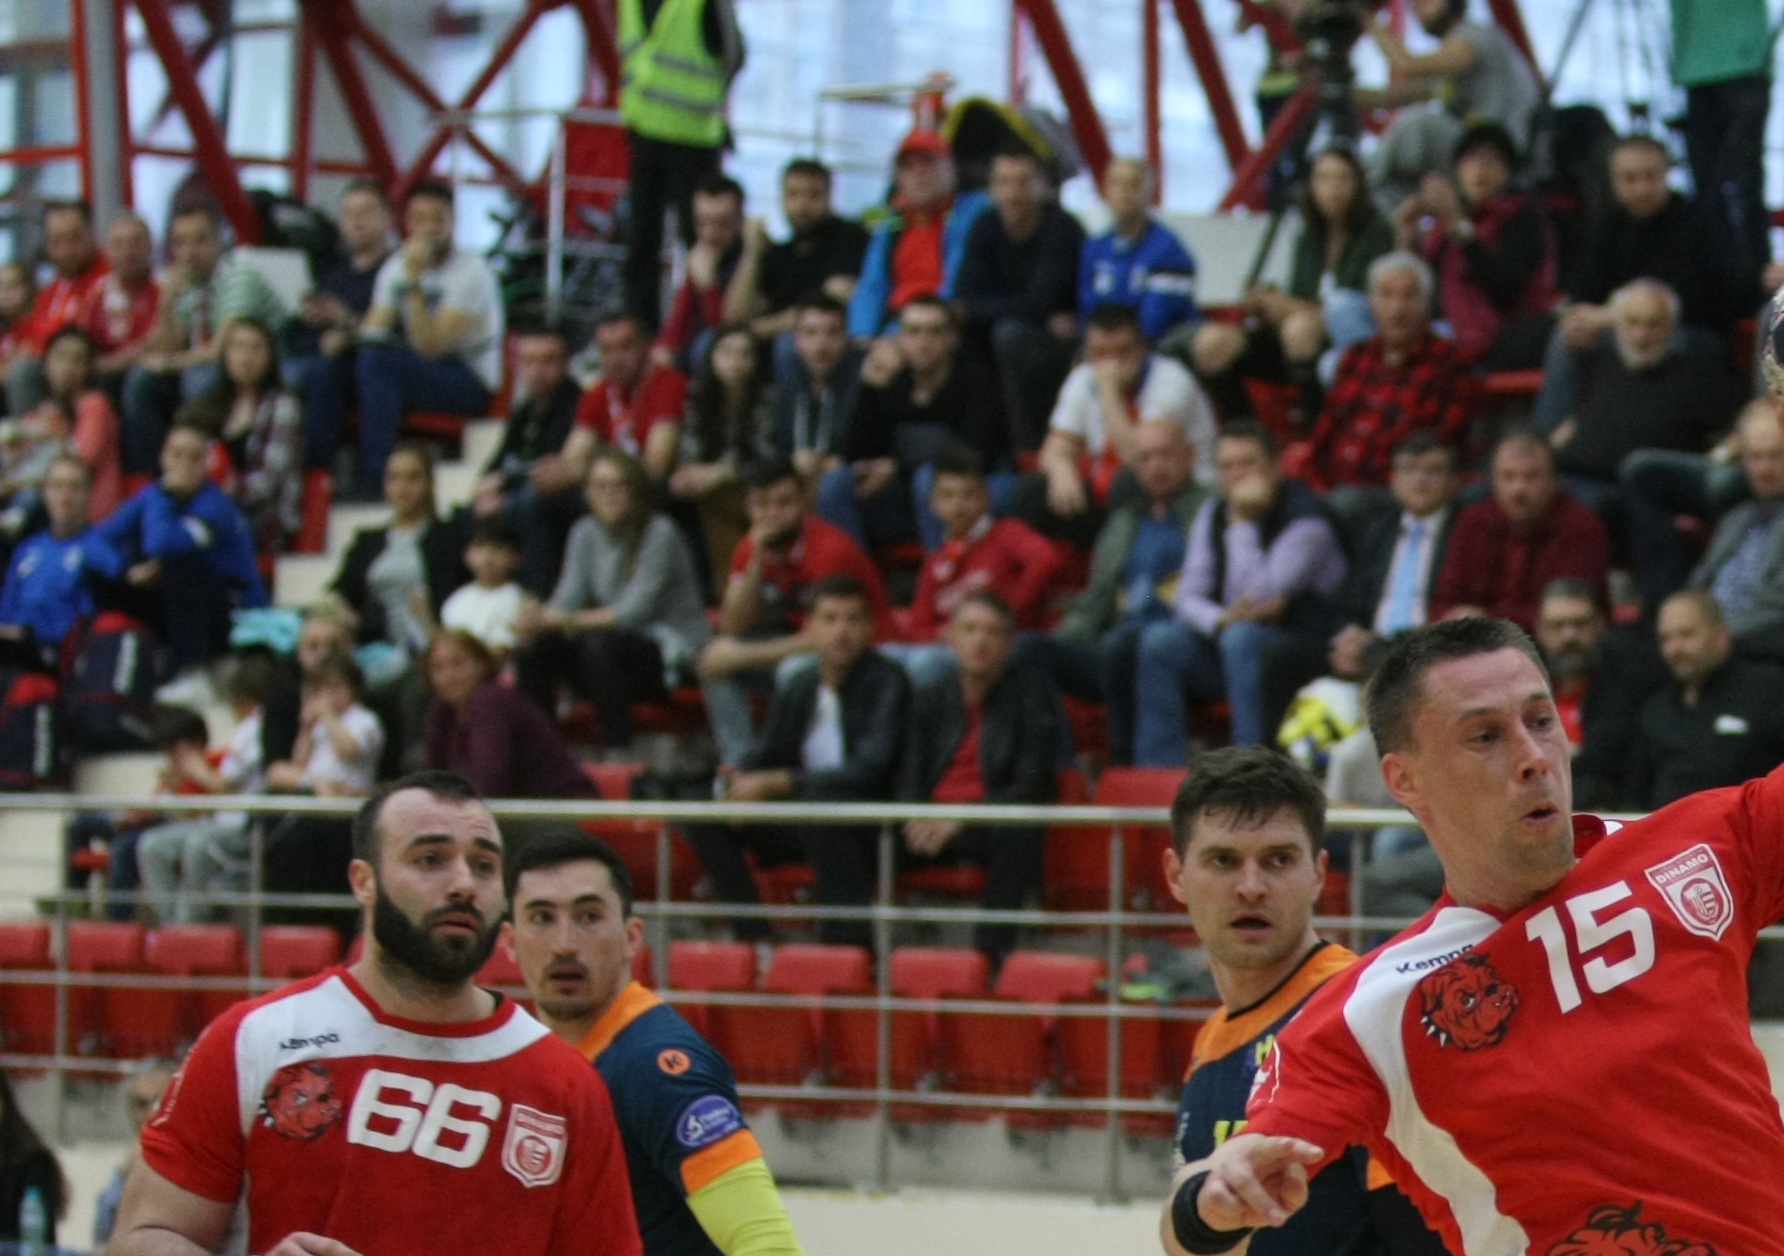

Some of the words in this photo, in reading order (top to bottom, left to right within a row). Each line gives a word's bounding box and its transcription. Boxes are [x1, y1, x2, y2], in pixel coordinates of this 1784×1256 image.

[1655, 853, 1710, 885] DINAMO
[1525, 880, 1656, 1015] 15
[347, 1068, 502, 1169] 66
